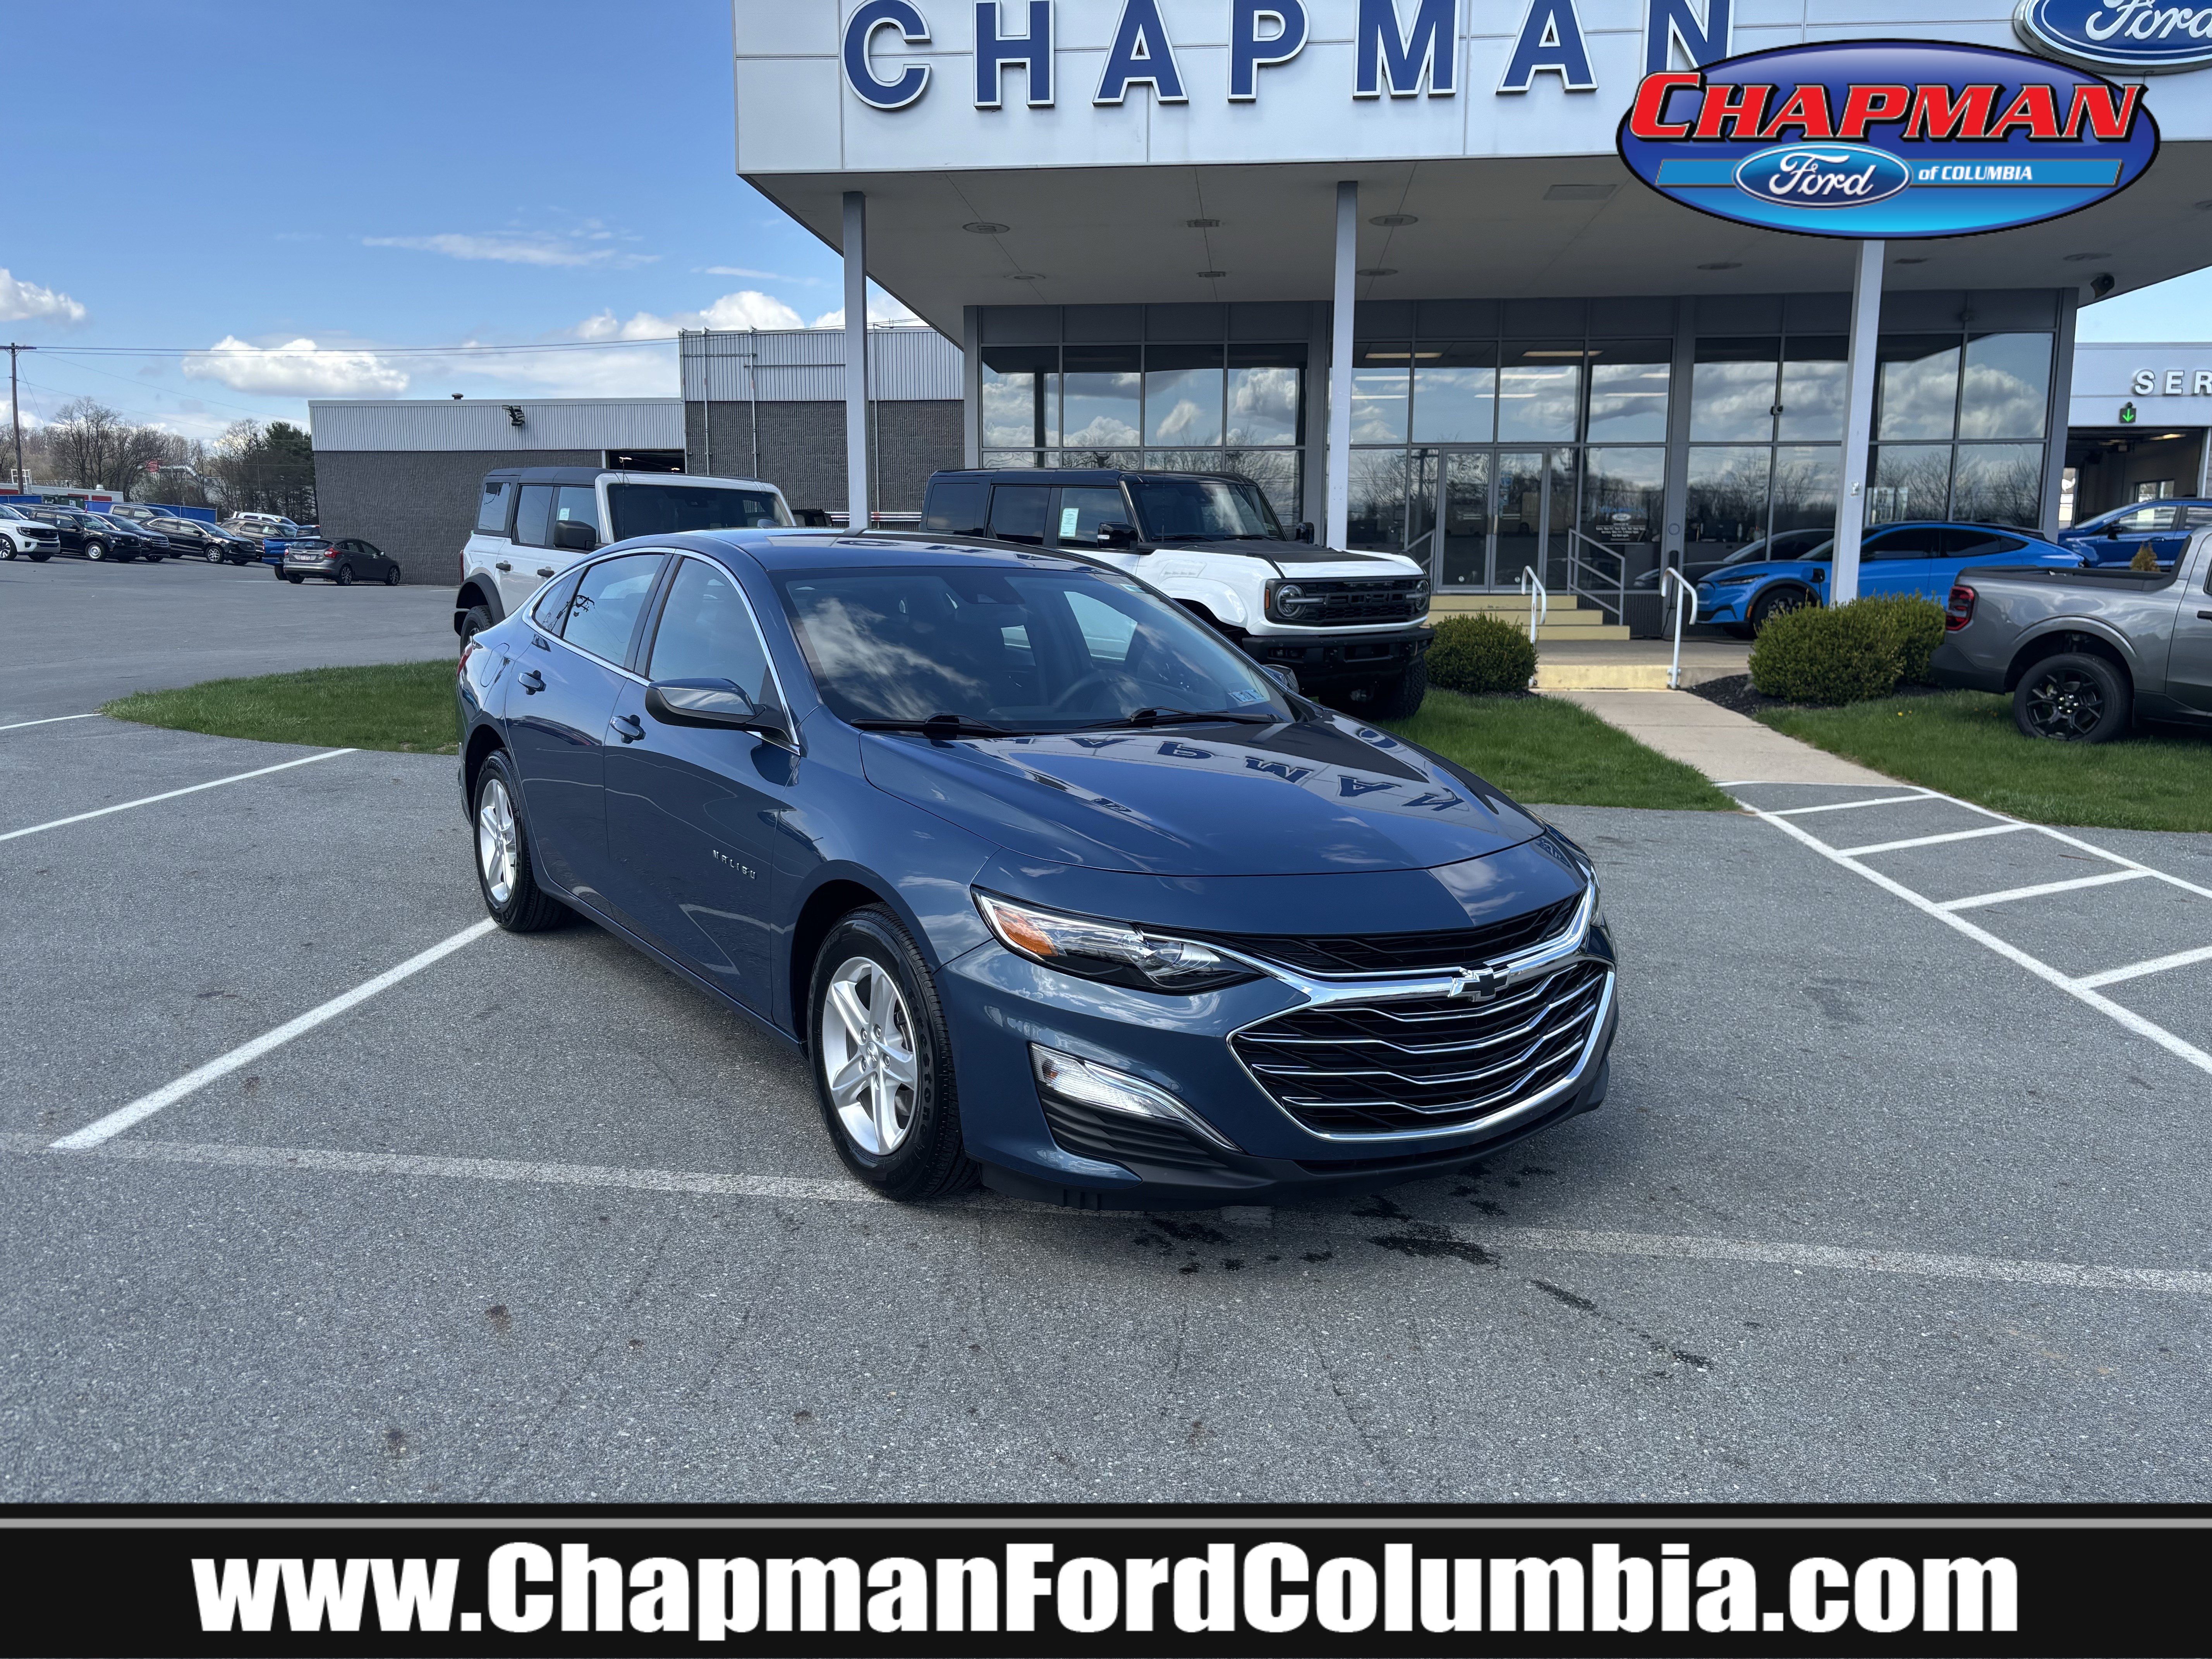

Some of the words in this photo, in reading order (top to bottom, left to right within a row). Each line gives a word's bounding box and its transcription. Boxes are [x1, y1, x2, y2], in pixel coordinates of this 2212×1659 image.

[842, 0, 1734, 110] CHAPMAN
[713, 850, 757, 880] MALIBU
[907, 987, 934, 1138] Firestone
